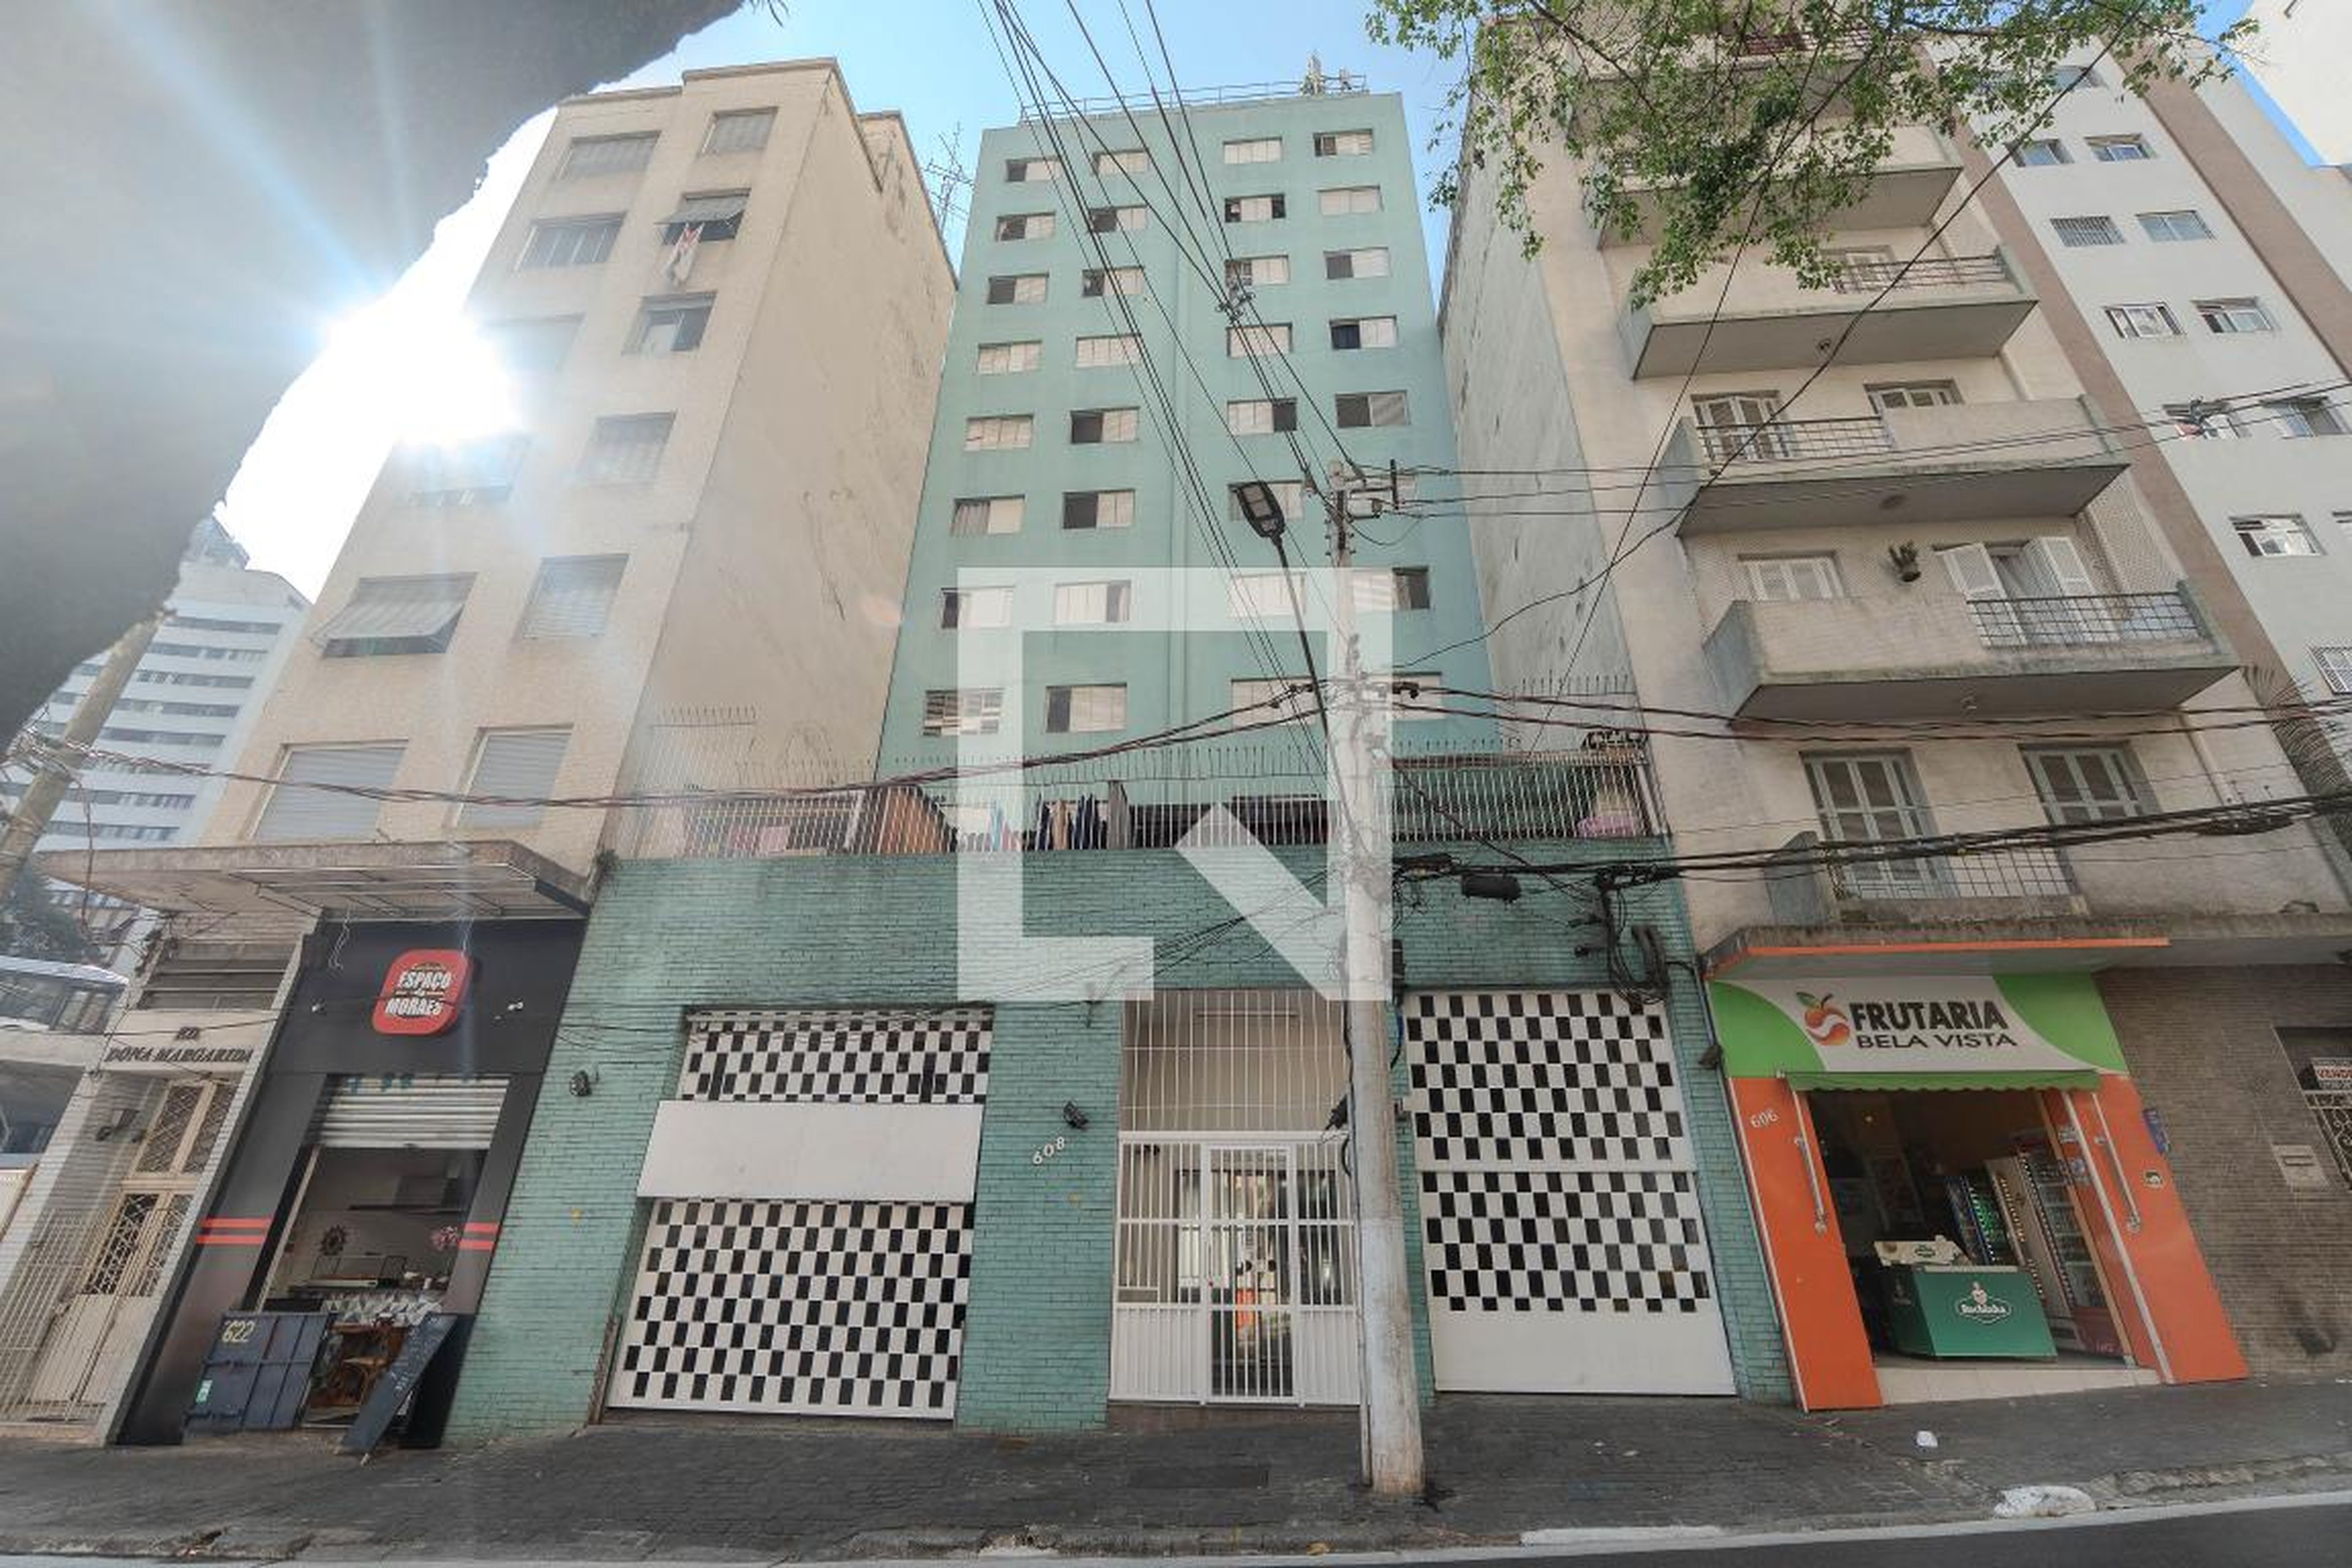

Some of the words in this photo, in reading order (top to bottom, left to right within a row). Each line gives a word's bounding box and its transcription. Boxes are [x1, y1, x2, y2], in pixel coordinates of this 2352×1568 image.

[385, 997, 442, 1016] MORAES
[1850, 1001, 2008, 1030] FRUTARIA
[1856, 1035, 1928, 1048] BELA
[1934, 1033, 2018, 1047] VISTA
[104, 1047, 154, 1062] DONA
[1751, 1109, 1777, 1128] 606
[1032, 1136, 1065, 1164] 608
[222, 1320, 255, 1343] 622
